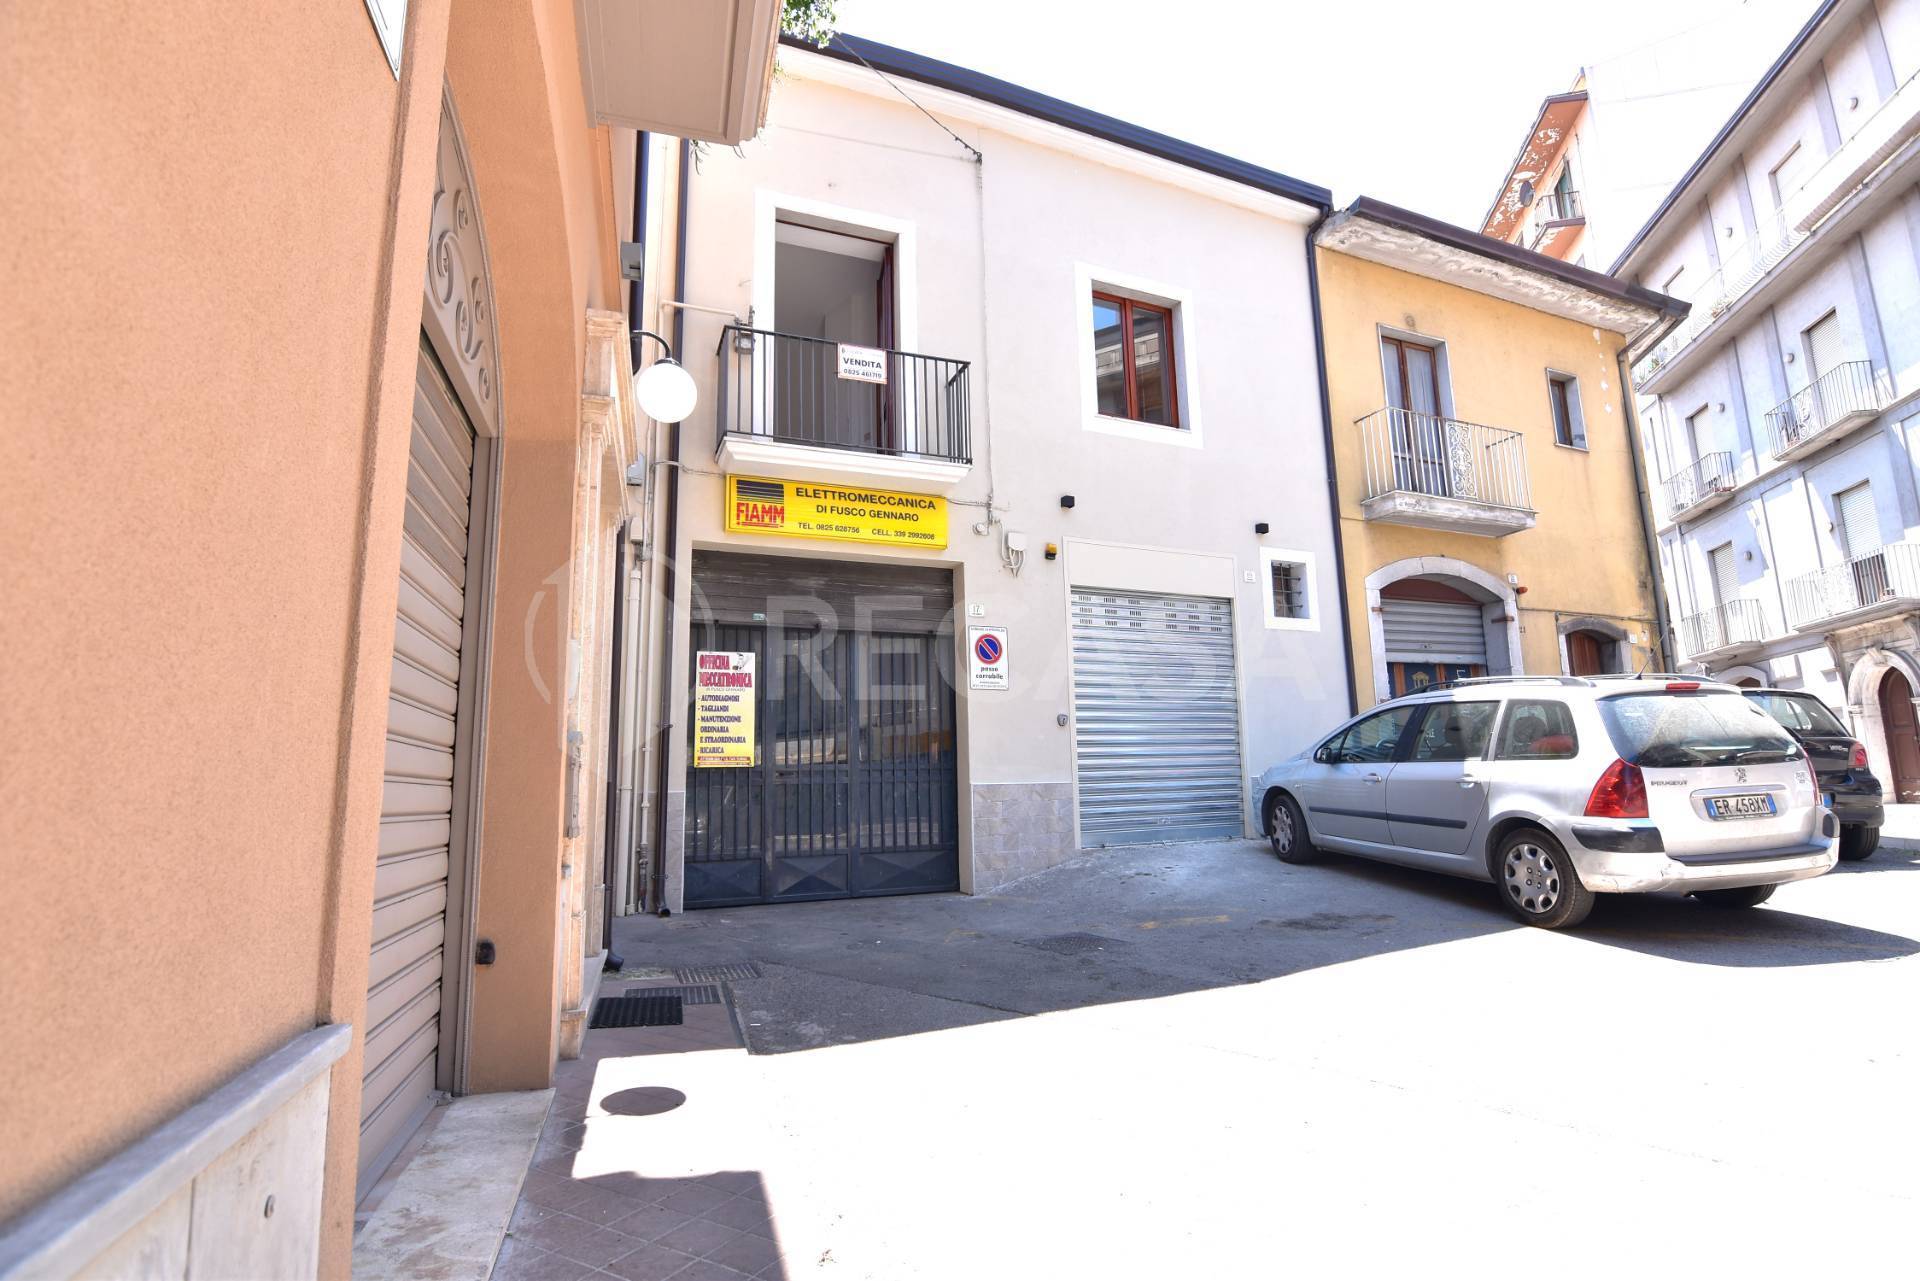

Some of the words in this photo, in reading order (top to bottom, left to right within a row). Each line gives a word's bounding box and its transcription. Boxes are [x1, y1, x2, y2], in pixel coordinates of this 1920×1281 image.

[843, 357, 882, 369] VENDITA
[796, 487, 936, 510] ELETTROMECCANICA
[736, 502, 784, 523] FIAMM
[816, 504, 828, 514] DI
[830, 505, 866, 518] FUSCO
[869, 509, 919, 522] GENNARO
[798, 522, 814, 530] TEL.
[816, 523, 833, 531] 0825
[872, 528, 892, 537] CELL.
[699, 655, 730, 670] OFFICINA
[699, 672, 752, 688] MECCATRONICA
[701, 694, 740, 703] AUTODIAGNOSI
[701, 715, 741, 723] MANUTENZIONE
[703, 736, 746, 744] STRAORDINARIA
[1714, 798, 1732, 815] ER
[1736, 796, 1769, 814] 458XM
